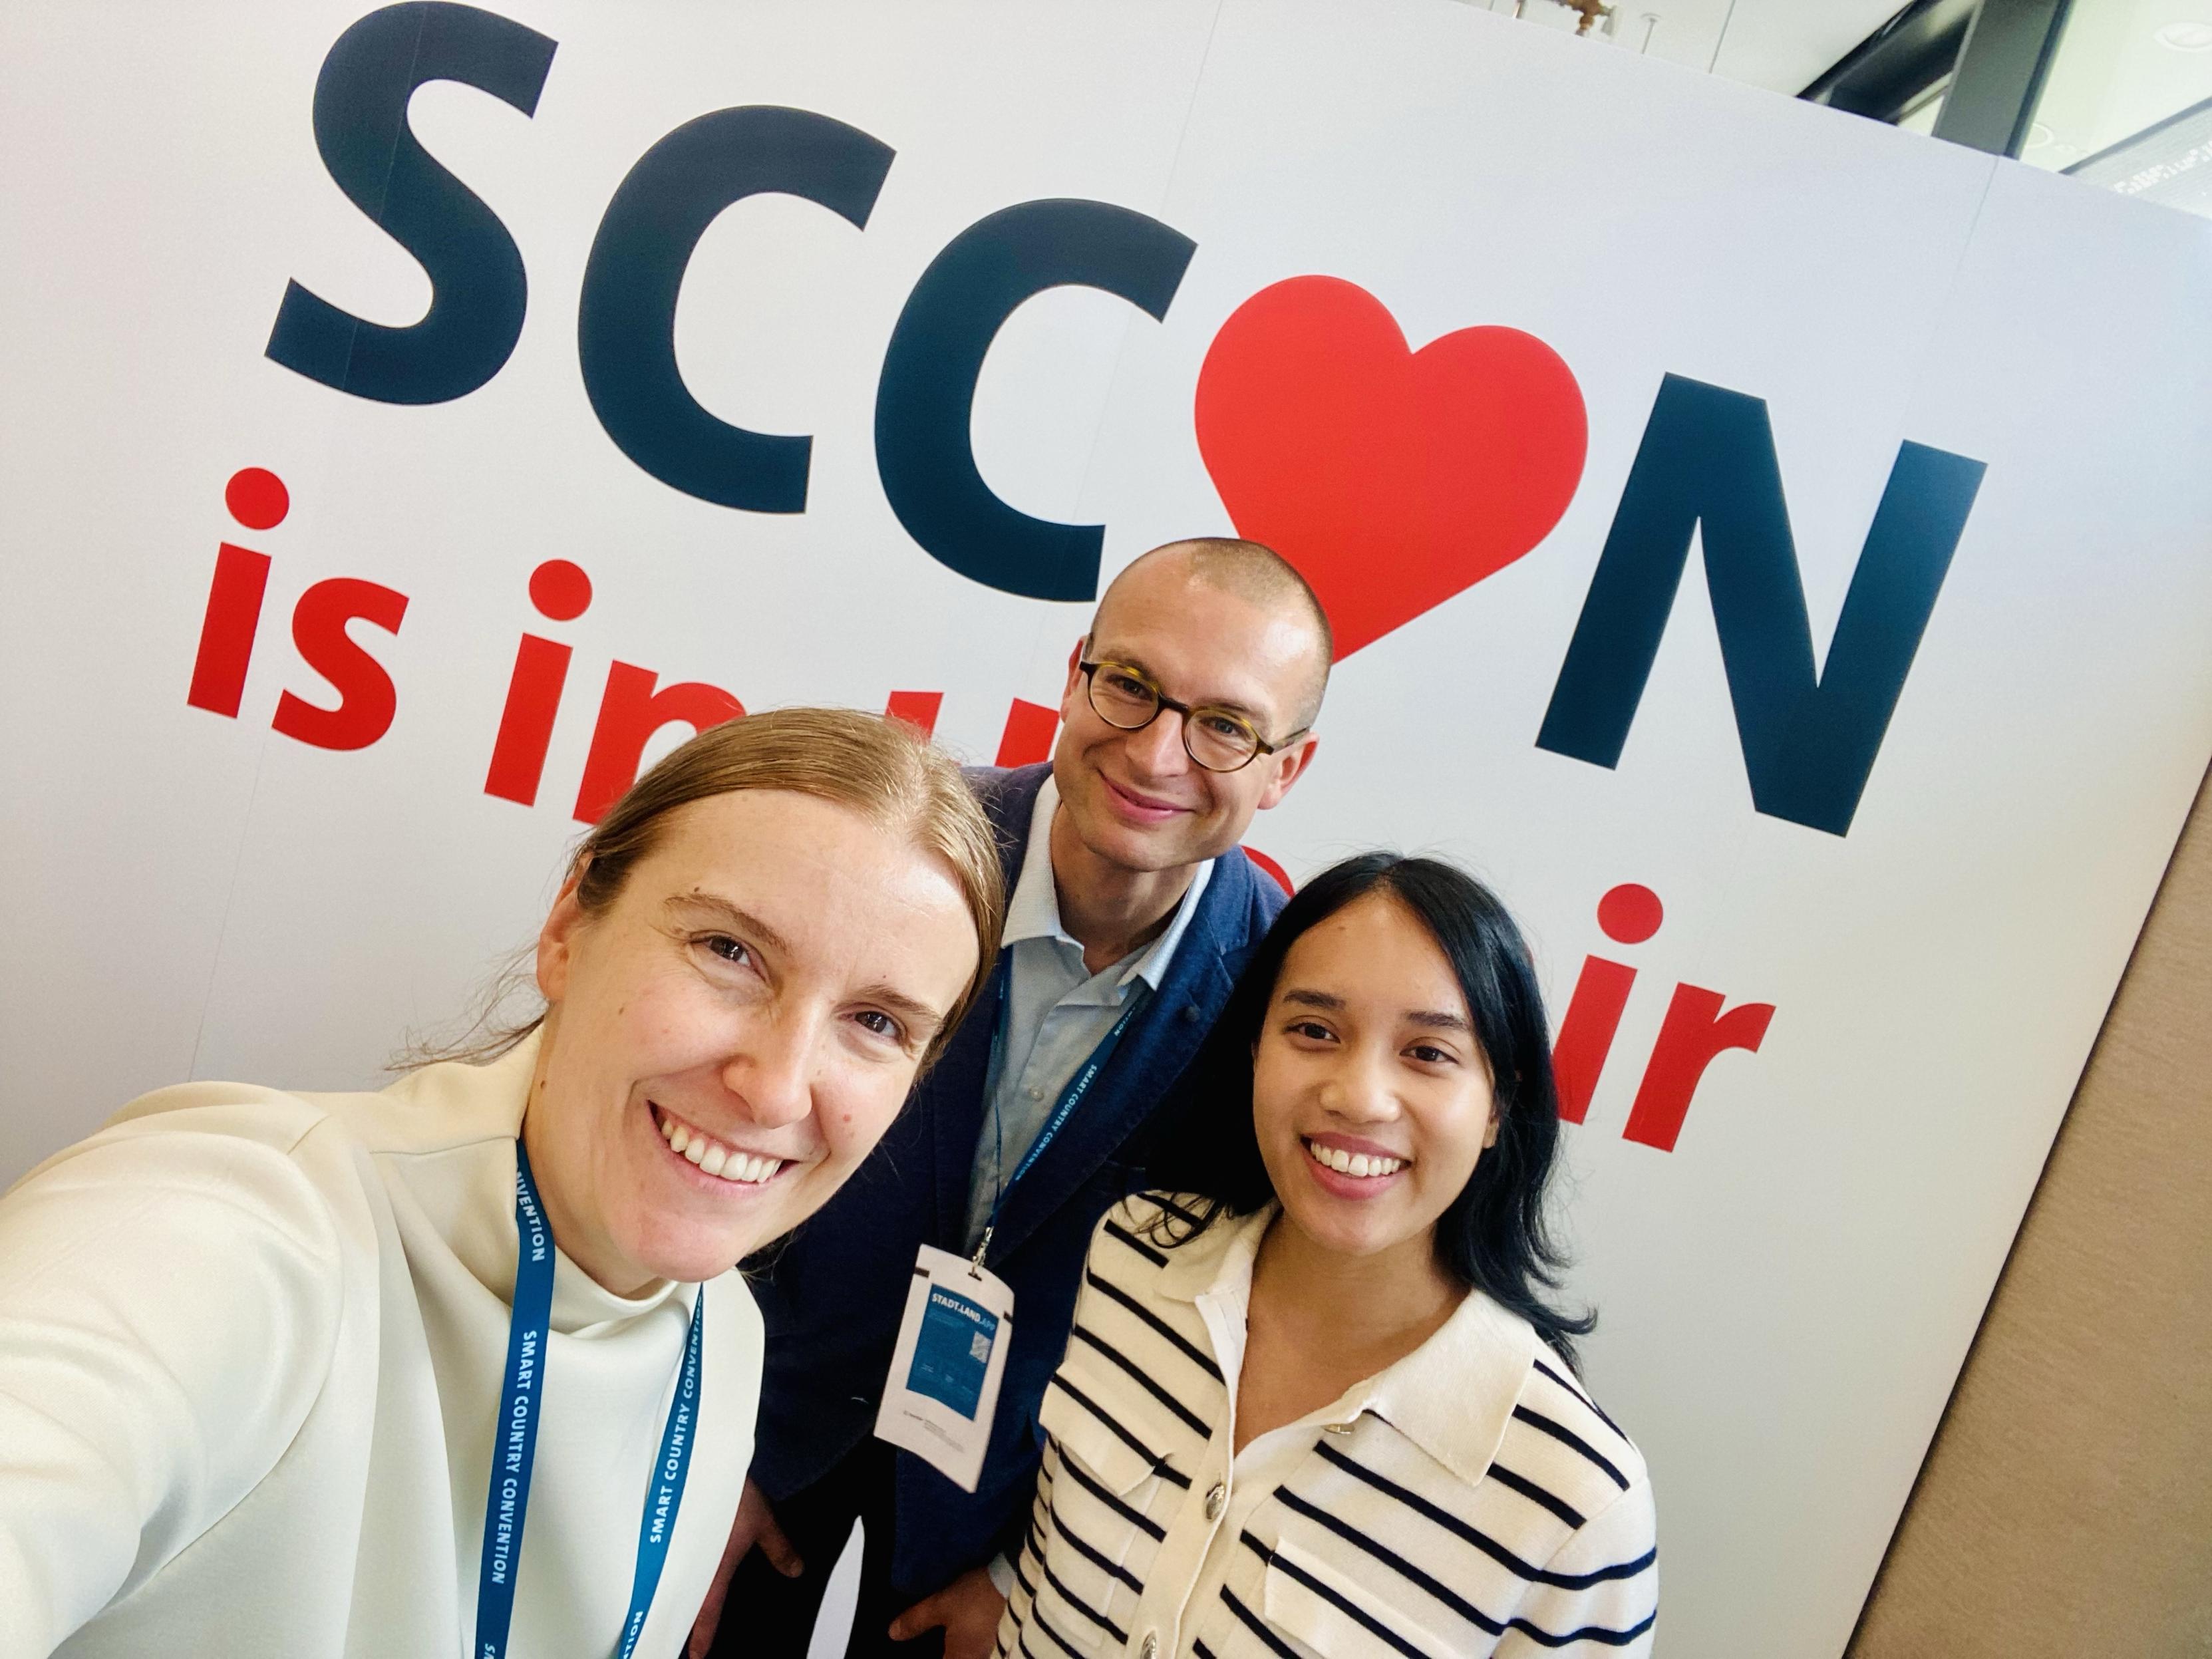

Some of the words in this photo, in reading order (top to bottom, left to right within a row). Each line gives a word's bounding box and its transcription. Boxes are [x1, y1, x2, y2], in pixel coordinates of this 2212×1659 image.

[187, 467, 410, 752] is
[484, 559, 747, 826] in
[1551, 883, 1776, 1153] ir
[1051, 1093, 1079, 1131] COUNTRY
[1076, 1064, 1097, 1094] SMART
[516, 1330, 537, 1390] SMART
[506, 1396, 529, 1473] COUNTRY
[650, 1485, 673, 1543] SMART
[665, 1403, 691, 1481] COUNTRY
[492, 1478, 518, 1584] CONVENTION
